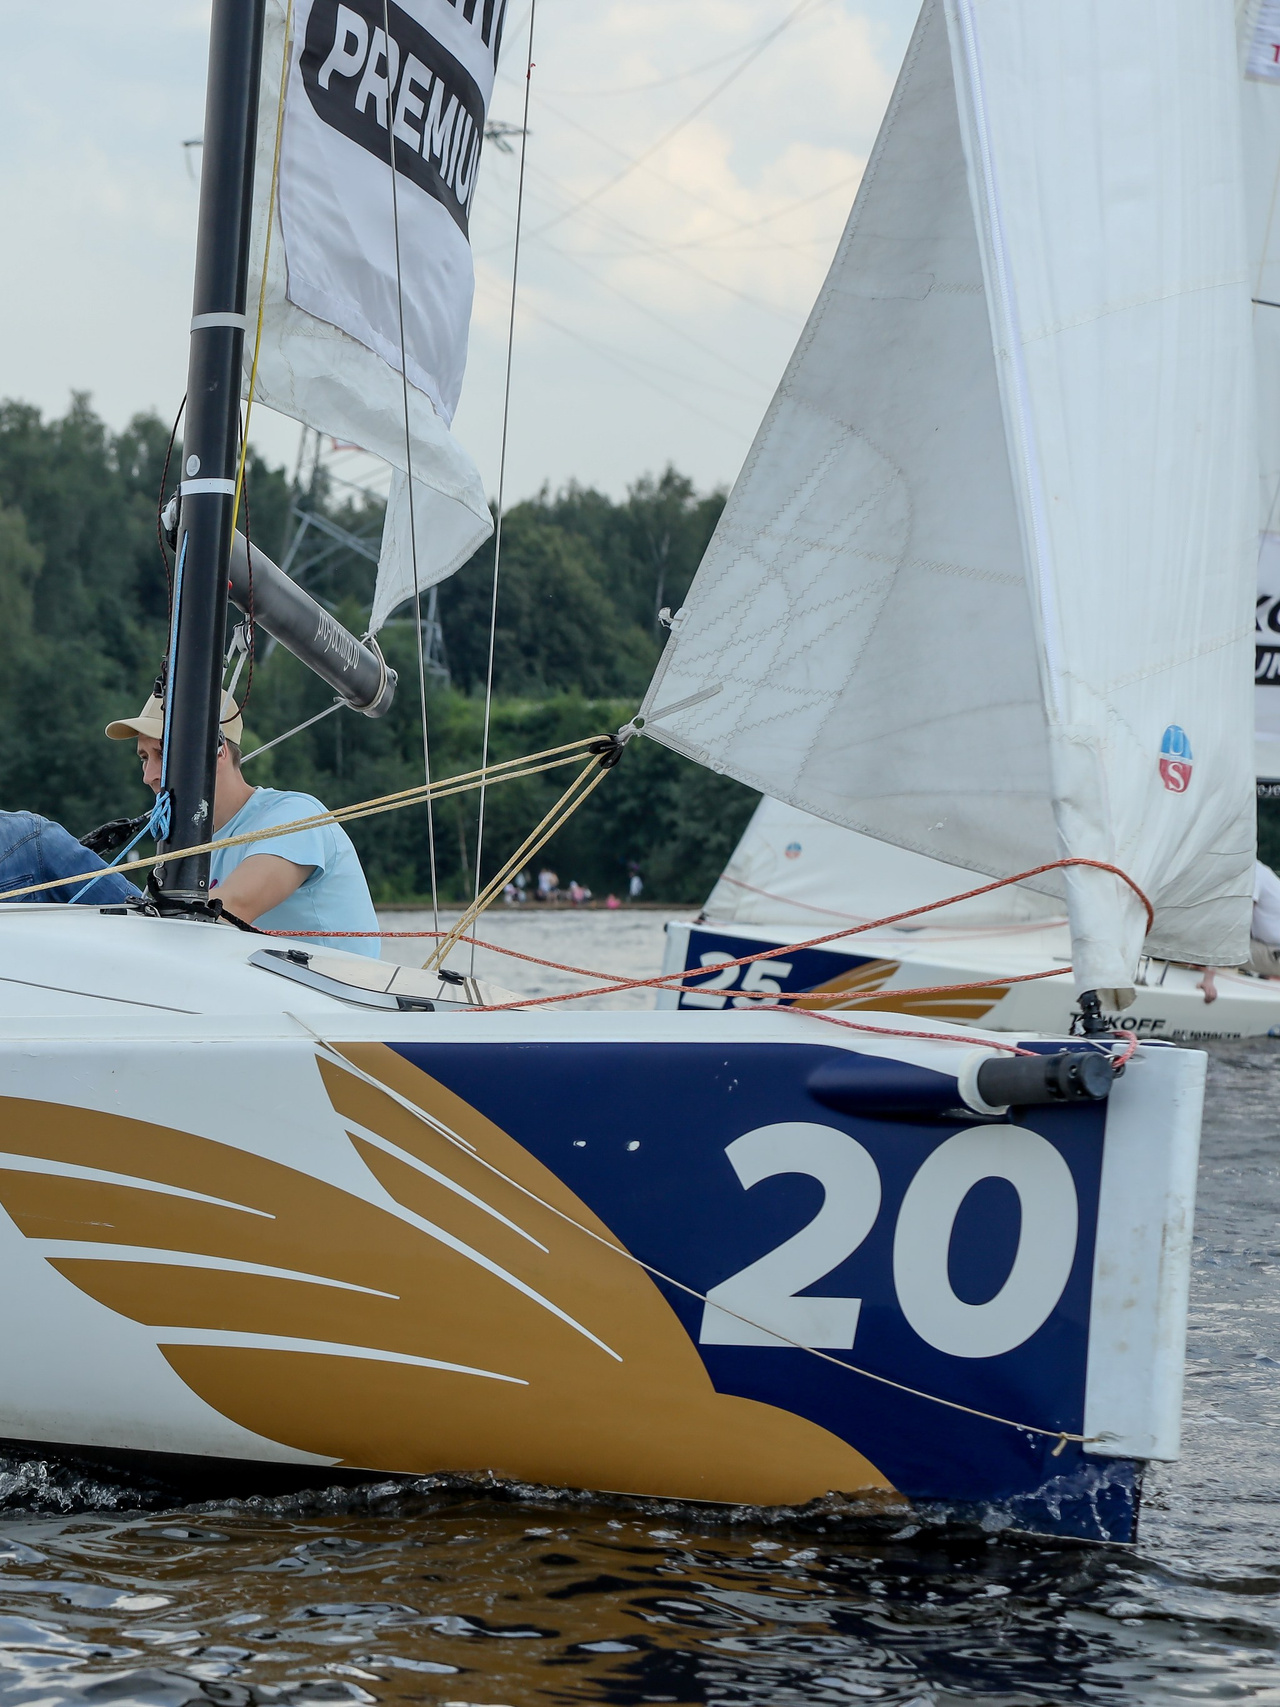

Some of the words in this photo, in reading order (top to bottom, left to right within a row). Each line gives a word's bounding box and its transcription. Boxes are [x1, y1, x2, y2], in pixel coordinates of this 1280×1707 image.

[318, 3, 480, 219] PREMIU
[680, 951, 793, 1009] 25
[699, 1121, 1079, 1358] 20
